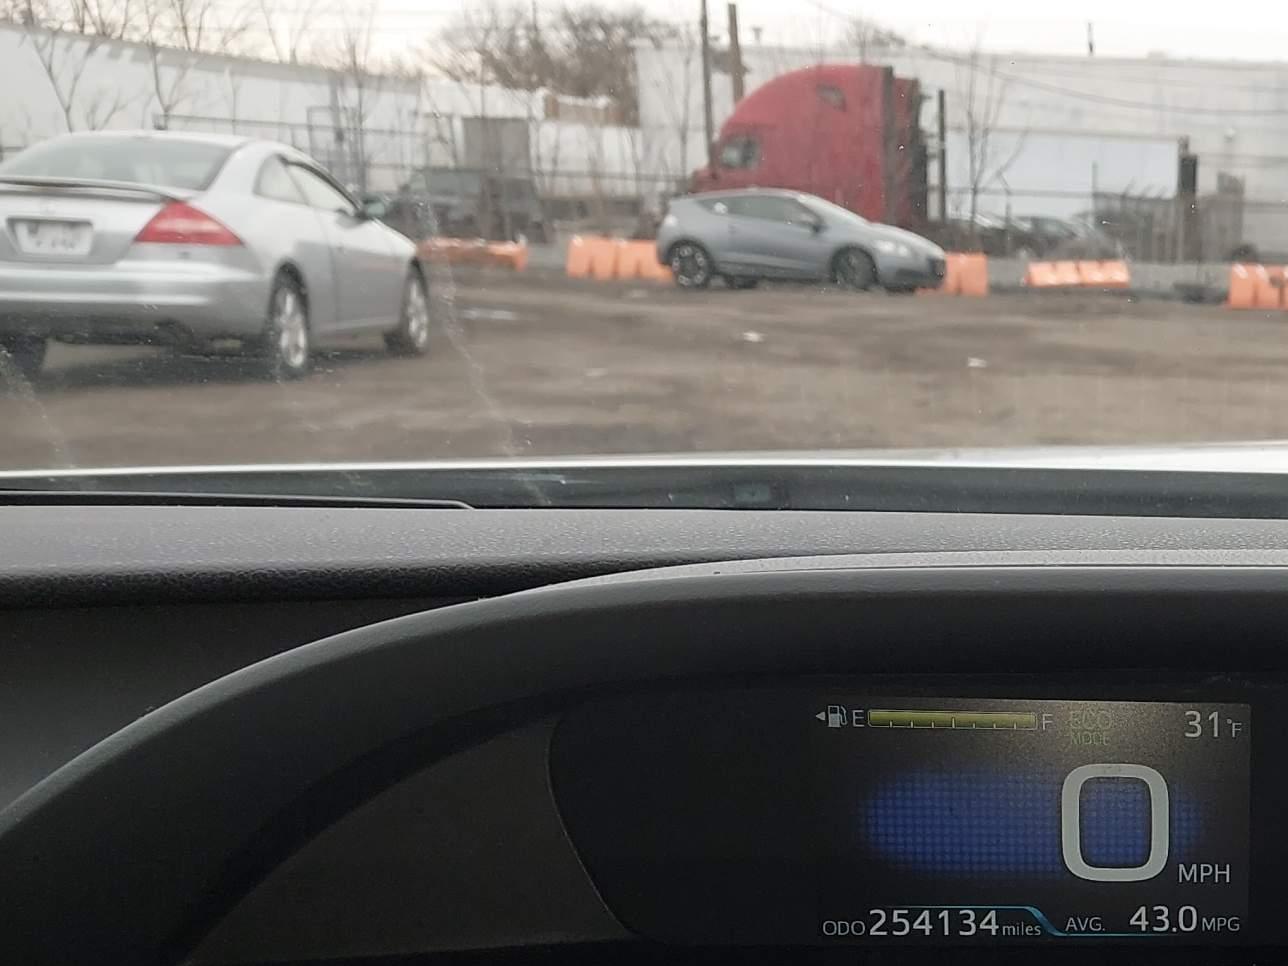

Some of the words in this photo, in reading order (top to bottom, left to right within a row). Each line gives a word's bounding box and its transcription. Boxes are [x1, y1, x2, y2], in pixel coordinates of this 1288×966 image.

[852, 710, 865, 728] E
[1041, 712, 1054, 731] F
[1184, 711, 1219, 738] 31
[1061, 763, 1170, 882] 0
[1177, 863, 1232, 884] MPH
[822, 920, 867, 936] ODO
[868, 908, 1000, 937] 254134
[1001, 921, 1042, 937] miles
[1064, 915, 1106, 933] AVG.
[1129, 904, 1198, 933] 43.0
[1202, 916, 1241, 933] MPG
